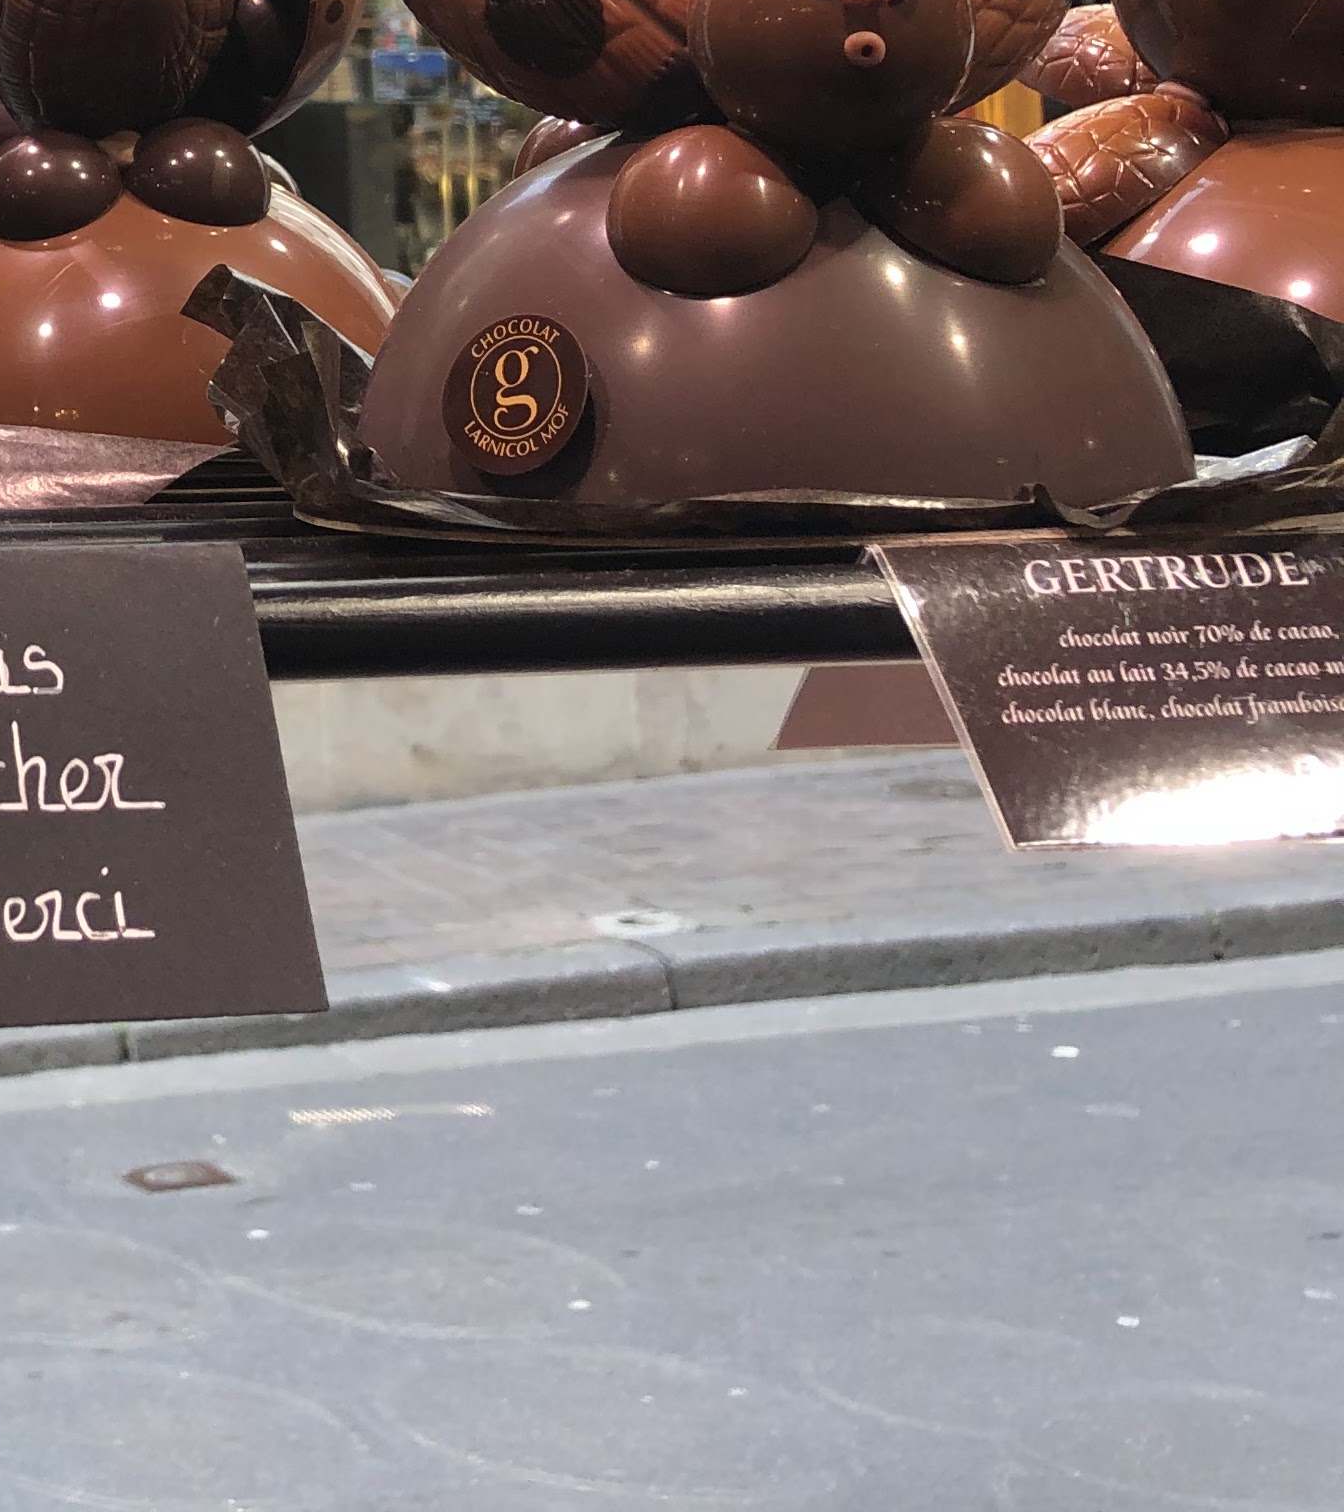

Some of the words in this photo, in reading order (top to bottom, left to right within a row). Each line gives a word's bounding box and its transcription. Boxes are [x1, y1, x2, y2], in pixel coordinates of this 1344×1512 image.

[470, 318, 561, 359] CHOCOLAT
[493, 345, 539, 431] g
[463, 420, 539, 458] LARNICOL
[540, 404, 570, 445] MOF
[1023, 550, 1310, 595] GERTRUDE
[1058, 624, 1141, 648] chocolat
[1146, 624, 1190, 645] noir
[1192, 623, 1246, 644] 70%
[1249, 619, 1274, 642] de
[997, 663, 1081, 687] chocolat
[1087, 668, 1116, 684] au
[1119, 660, 1157, 683] lait
[1160, 660, 1231, 682] 34,5%
[1235, 656, 1259, 679] de
[1001, 700, 1086, 725] chocolat
[1089, 697, 1156, 722] blanc,
[1160, 693, 1244, 719] chocolat
